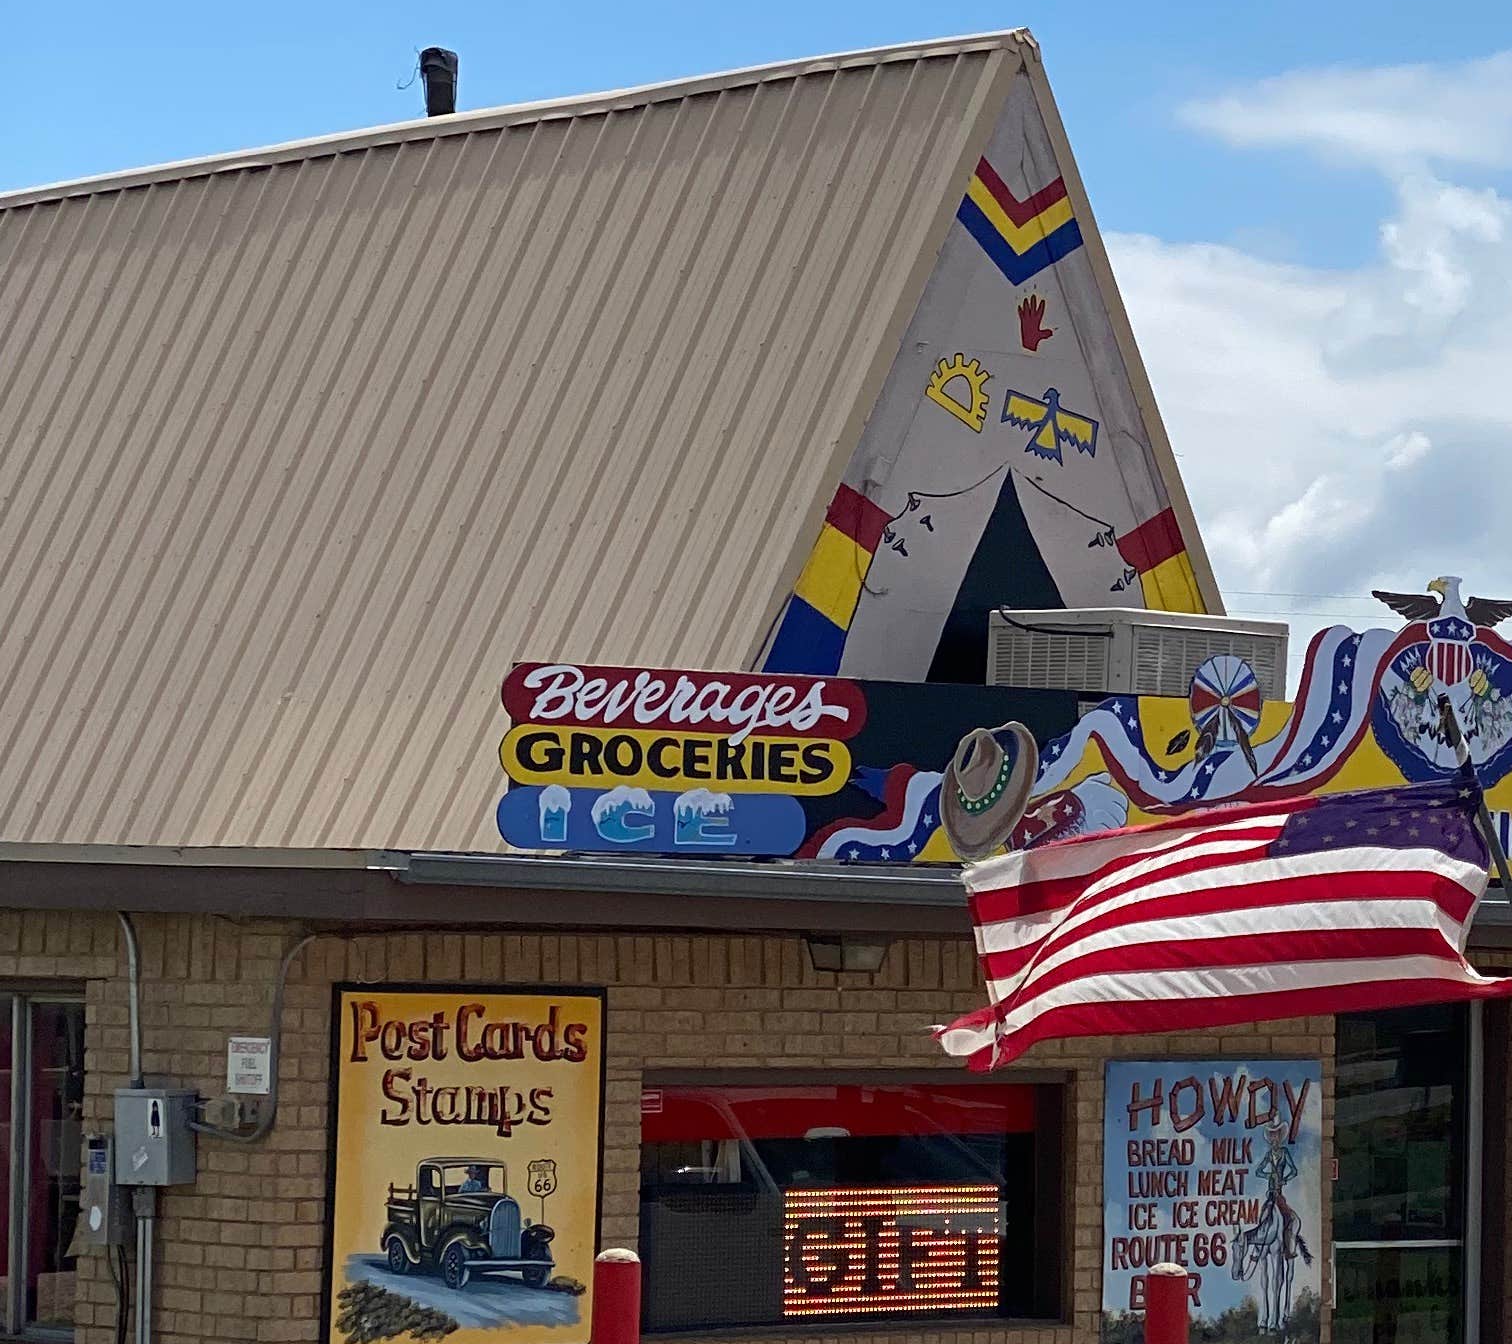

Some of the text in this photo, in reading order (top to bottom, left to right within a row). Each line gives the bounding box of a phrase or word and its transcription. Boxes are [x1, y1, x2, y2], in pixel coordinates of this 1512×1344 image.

[523, 664, 849, 745] Beverages
[515, 731, 835, 784] GROCERIES
[537, 784, 738, 846] ICE
[350, 1001, 588, 1063] Post Cards
[381, 1067, 554, 1138] Stamps
[1127, 1074, 1311, 1145] HOWDY
[1127, 1137, 1253, 1167] BREAD MILK
[534, 1179, 551, 1193] 66
[1127, 1168, 1249, 1199] LUNCH MEAT
[1128, 1198, 1260, 1231] ICE ICE CREAM
[1111, 1232, 1228, 1271] ROUTE 66
[1129, 1272, 1202, 1311] BR
